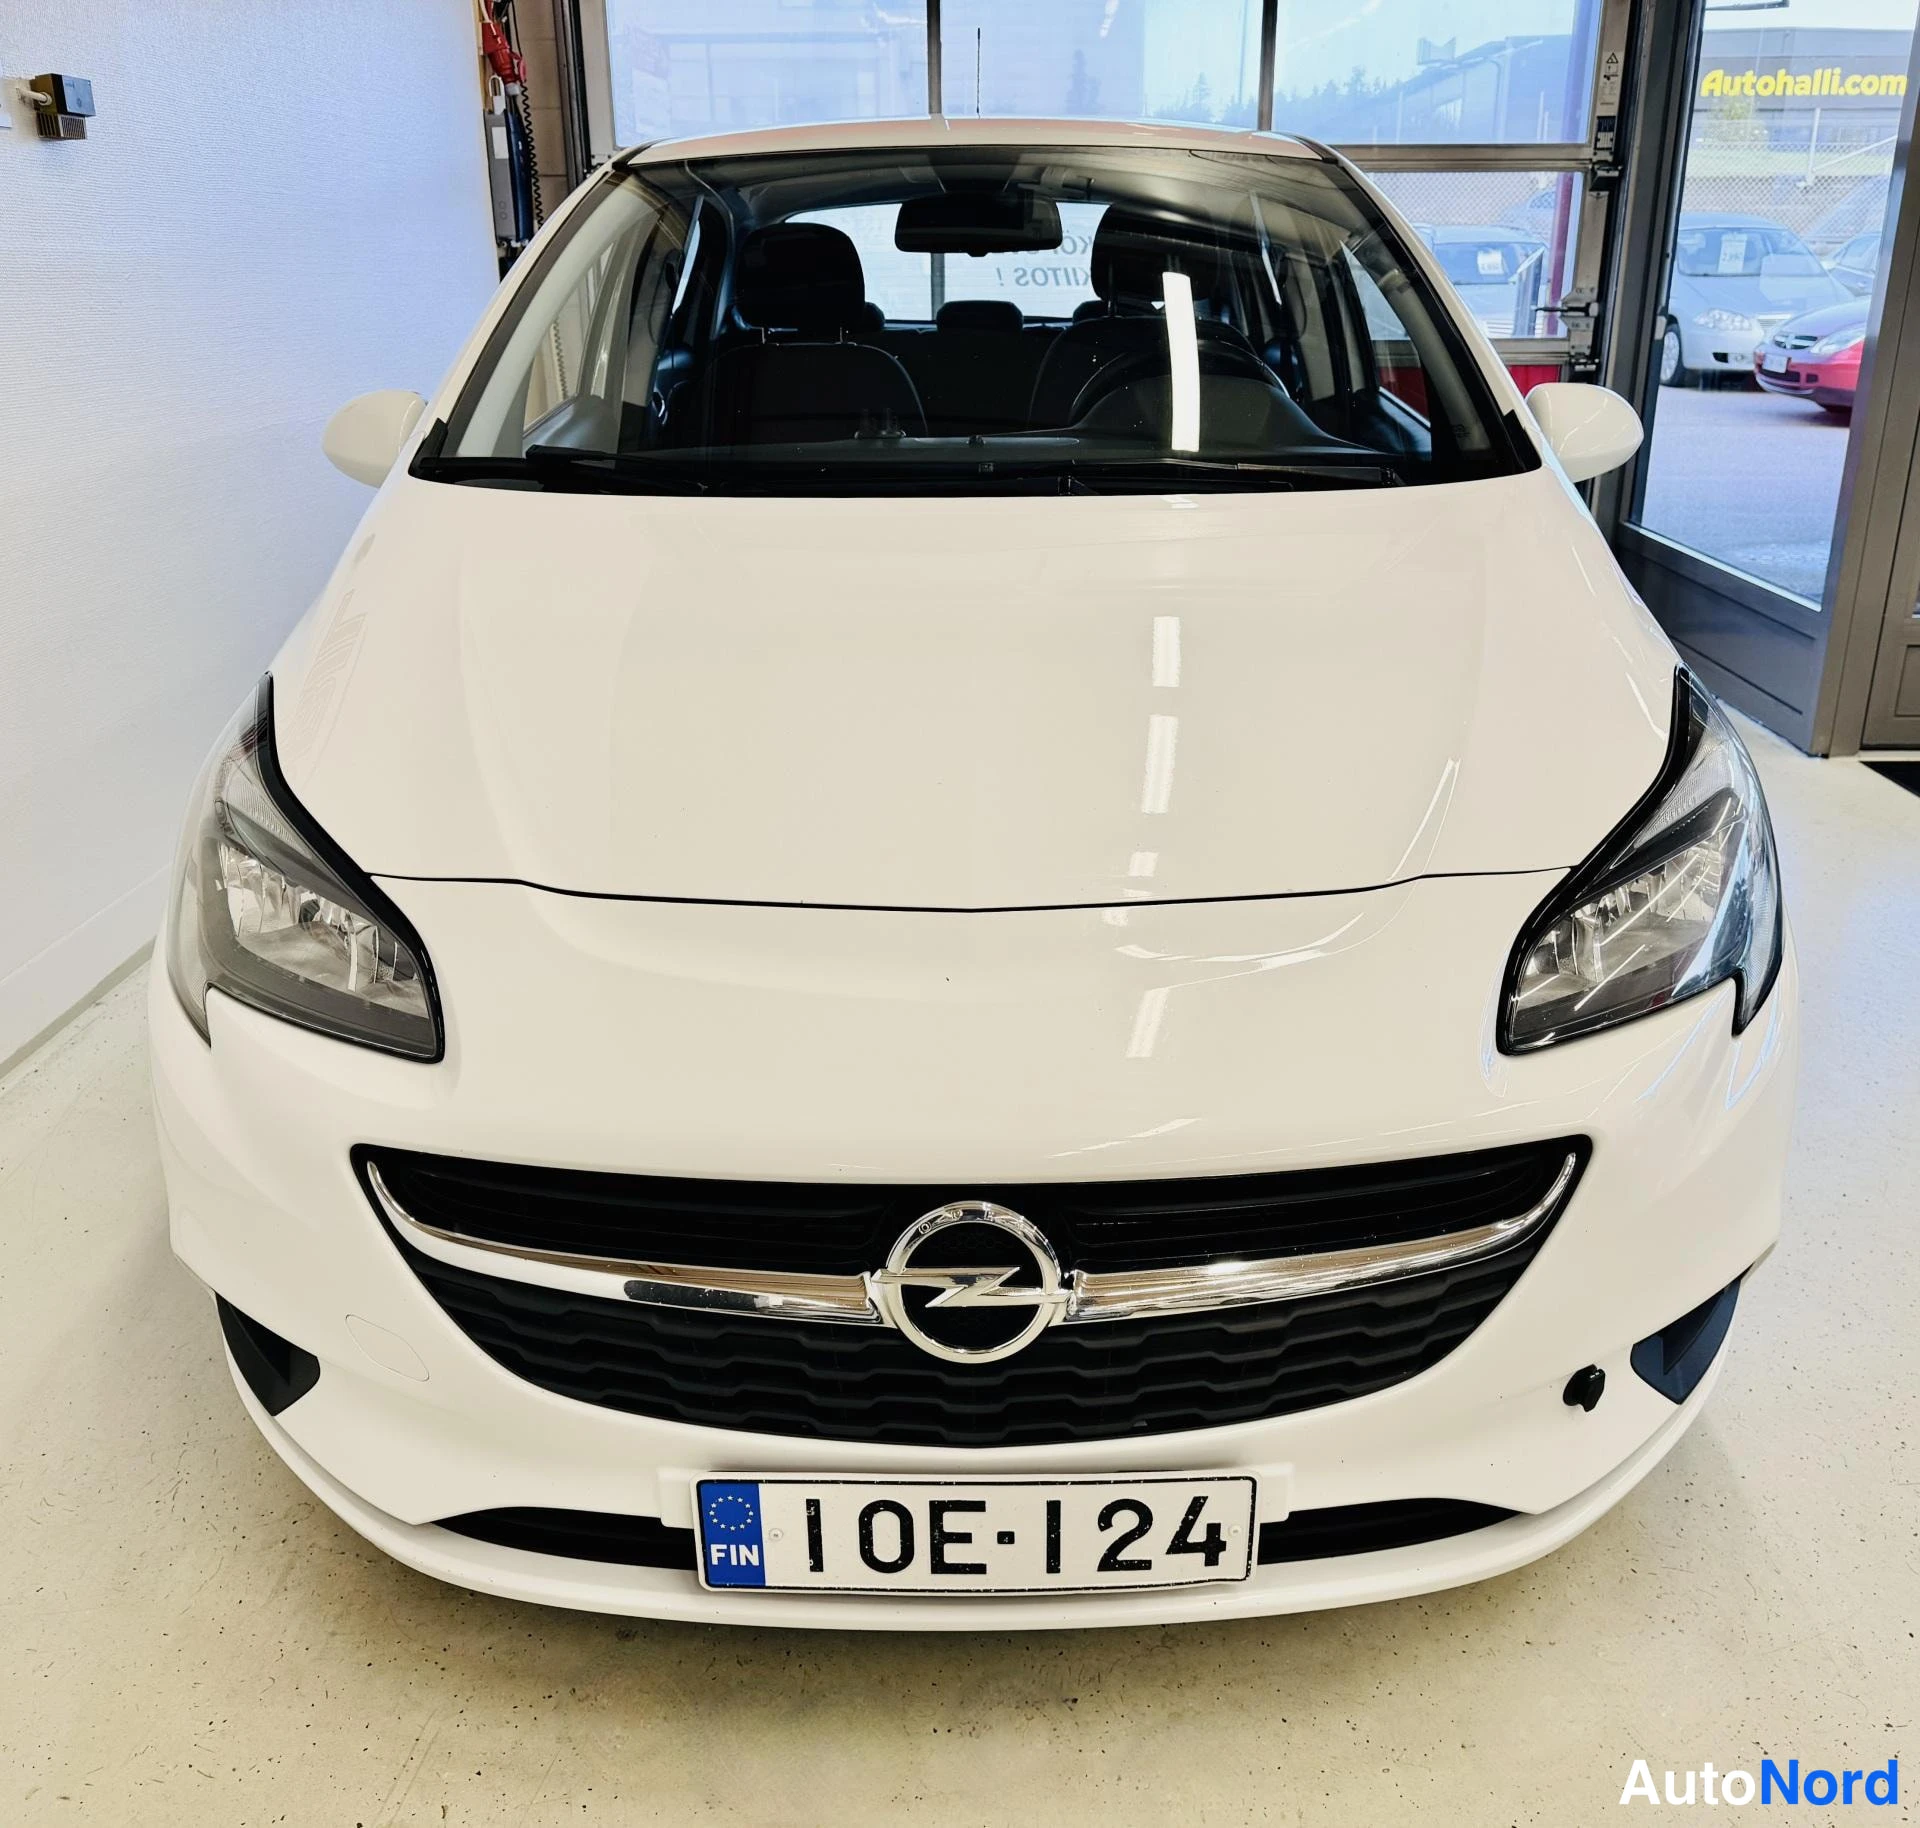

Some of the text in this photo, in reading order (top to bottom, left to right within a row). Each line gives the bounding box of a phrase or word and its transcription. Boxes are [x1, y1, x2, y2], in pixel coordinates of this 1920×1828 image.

[1700, 67, 1908, 97] Autohalli.com
[806, 1496, 1227, 1575] IOE-124
[710, 1544, 760, 1567] FIN
